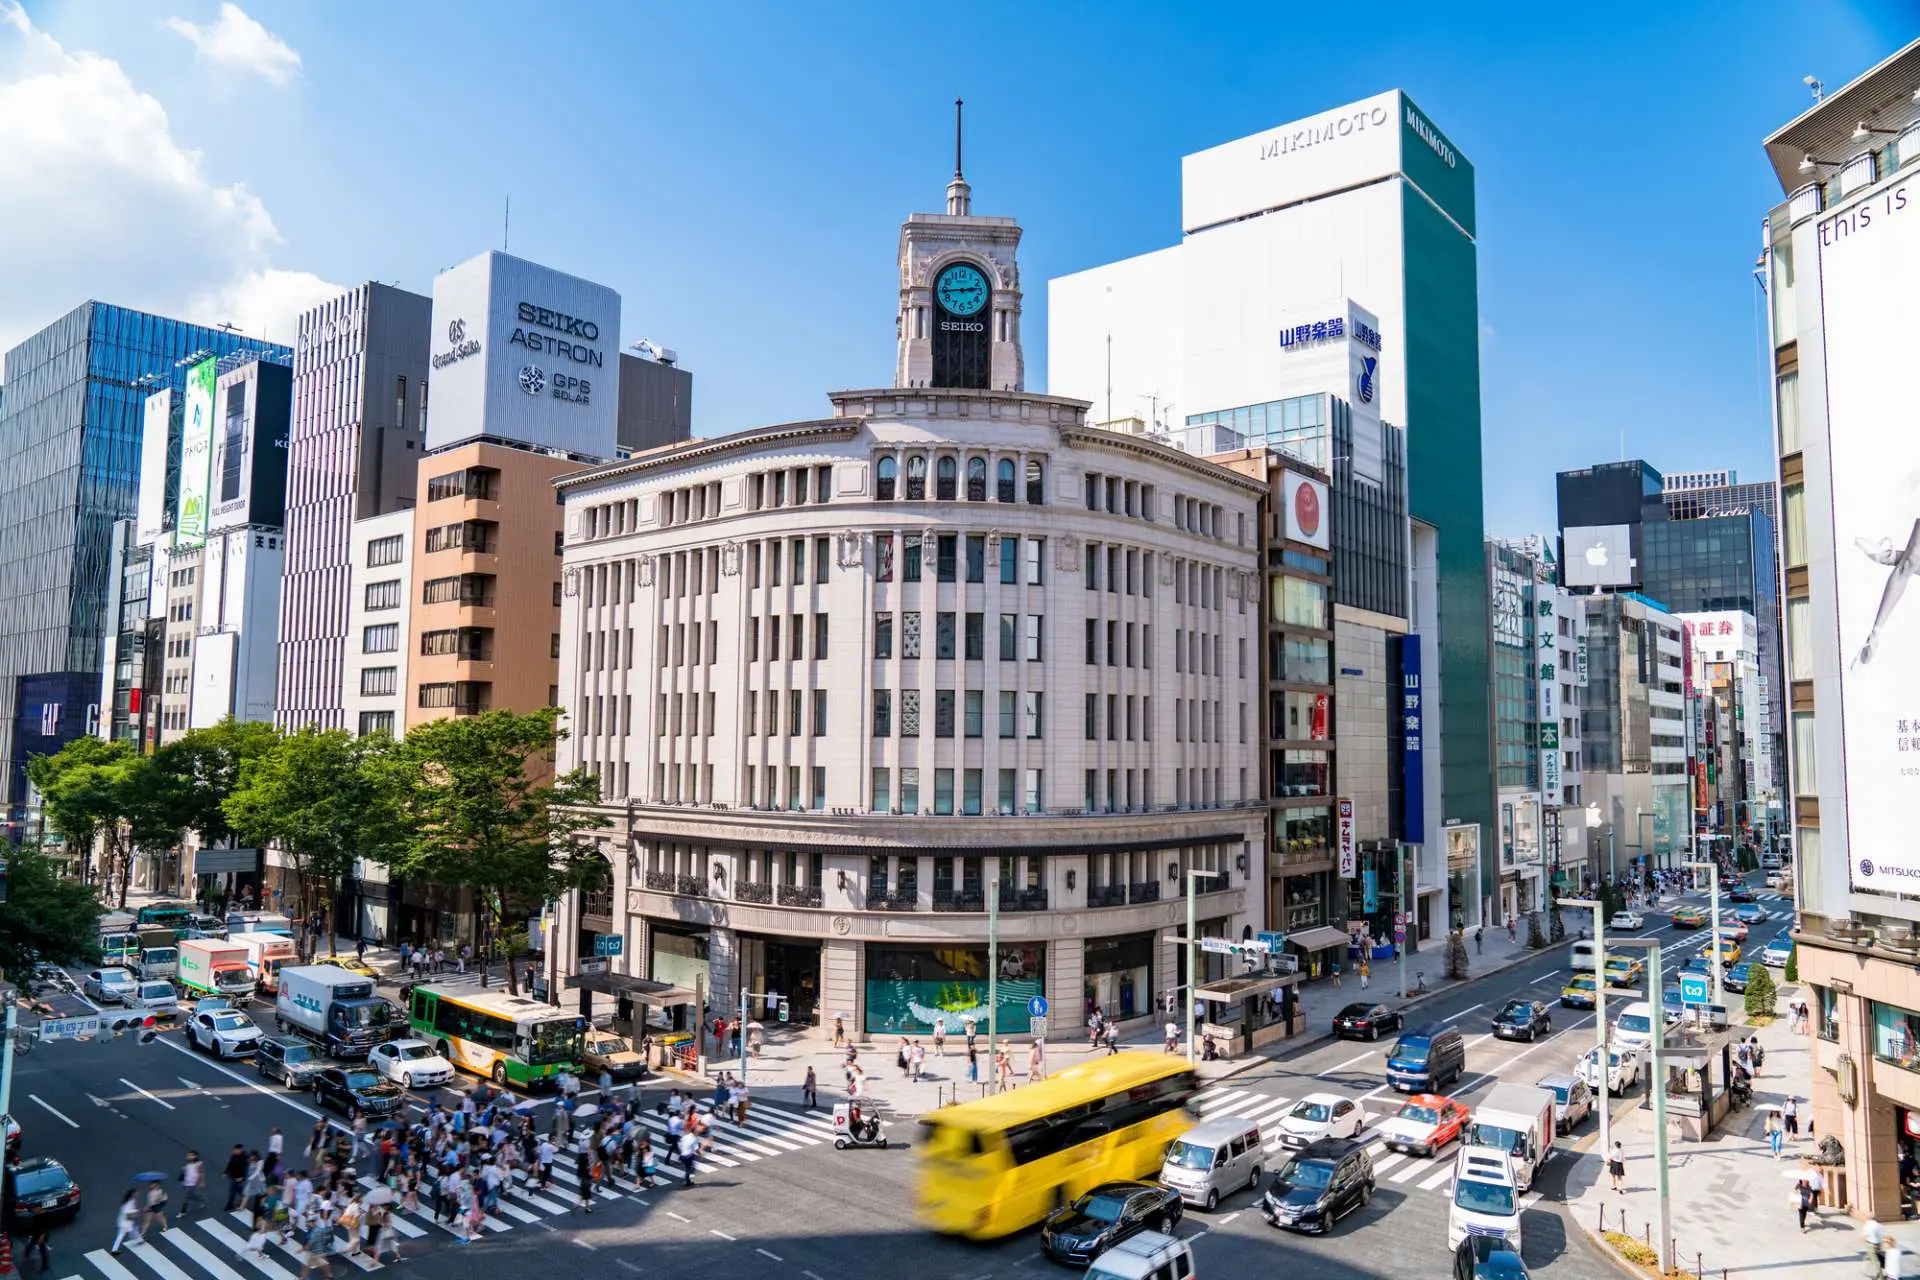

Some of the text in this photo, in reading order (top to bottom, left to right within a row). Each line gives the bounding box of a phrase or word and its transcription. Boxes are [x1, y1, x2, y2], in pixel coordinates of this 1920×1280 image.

[1260, 107, 1387, 161] MIKIMOTO
[1406, 106, 1456, 169] MIKIMOTO
[1820, 187, 1907, 247] this is
[298, 308, 360, 355] GUCCI
[518, 301, 599, 341] SEIKO
[940, 321, 984, 332] SEIKO
[1280, 317, 1343, 347] 山野楽器
[432, 340, 482, 370] Grand Seiko
[510, 328, 603, 368] ASTRON
[552, 389, 590, 405] SOLAR
[553, 373, 591, 395] GPS
[1538, 600, 1555, 682] 教文館
[42, 703, 59, 736] GAP
[1404, 673, 1420, 751] 山野楽器
[1541, 727, 1557, 745] 本
[1341, 820, 1352, 874] キムラヤのパン
